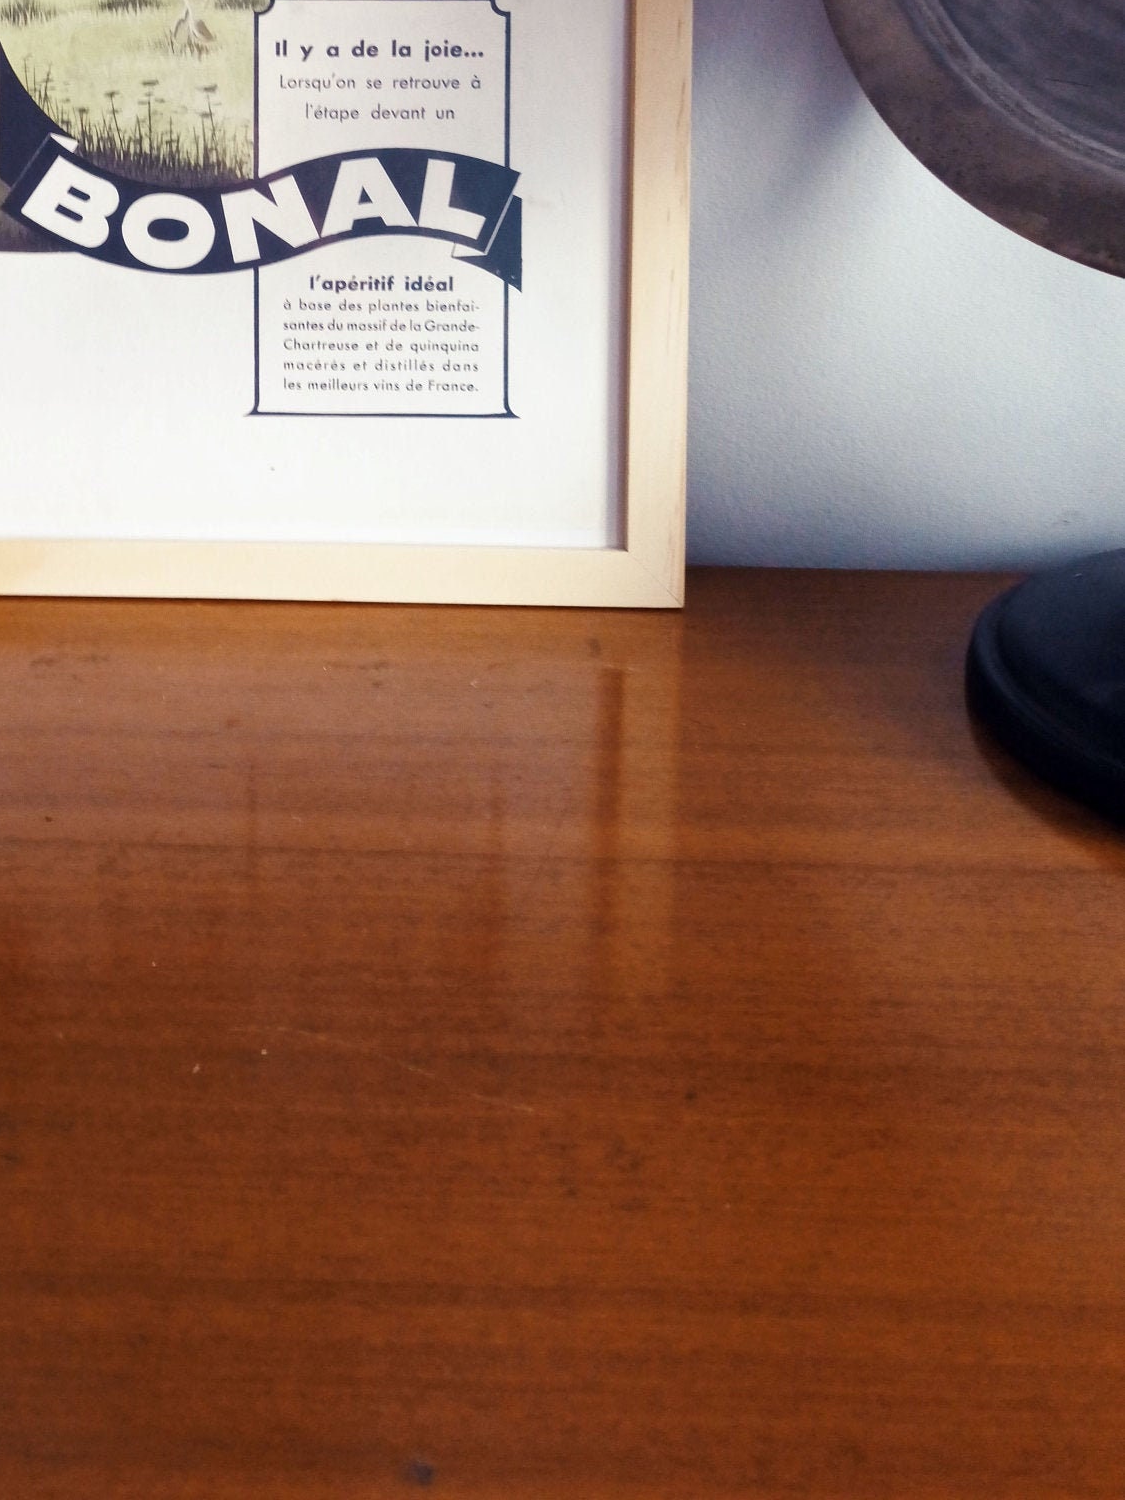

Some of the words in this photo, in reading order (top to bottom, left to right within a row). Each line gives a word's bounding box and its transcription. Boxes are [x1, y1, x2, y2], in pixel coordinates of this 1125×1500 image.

[275, 39, 287, 57] Il
[300, 45, 313, 62] y
[326, 45, 340, 58] a
[351, 39, 379, 58] de
[391, 39, 412, 58] la
[424, 39, 484, 62] joie...
[280, 72, 356, 93] Lorsqu'on
[366, 78, 382, 90] se
[392, 76, 461, 90] retrouve
[470, 74, 482, 90] à
[305, 102, 360, 124] l'étape
[371, 103, 426, 120] devant
[435, 108, 455, 120] un
[21, 155, 486, 269] BONAL
[309, 275, 395, 294] l'apéritif
[404, 275, 454, 292] idéal
[283, 299, 292, 311] à
[299, 298, 332, 311] base
[339, 299, 363, 311] des
[368, 299, 419, 315] plantes
[426, 299, 480, 312] bienfai-
[283, 320, 324, 331] santes
[327, 318, 343, 331] du
[347, 318, 388, 332] massif
[389, 319, 406, 332] de
[409, 319, 421, 332] la
[424, 319, 480, 332] Grande-
[283, 338, 359, 351] Chartreuse
[365, 340, 379, 352] et
[385, 338, 403, 352] de
[410, 341, 479, 355] quinquina
[283, 360, 346, 371] macérés
[353, 360, 368, 371] et
[374, 358, 435, 372] distillés
[442, 359, 479, 372] dans
[283, 378, 302, 391] les
[307, 378, 369, 391] meilleurs
[373, 380, 401, 391] vins
[405, 379, 423, 392] de
[427, 379, 479, 392] France.
